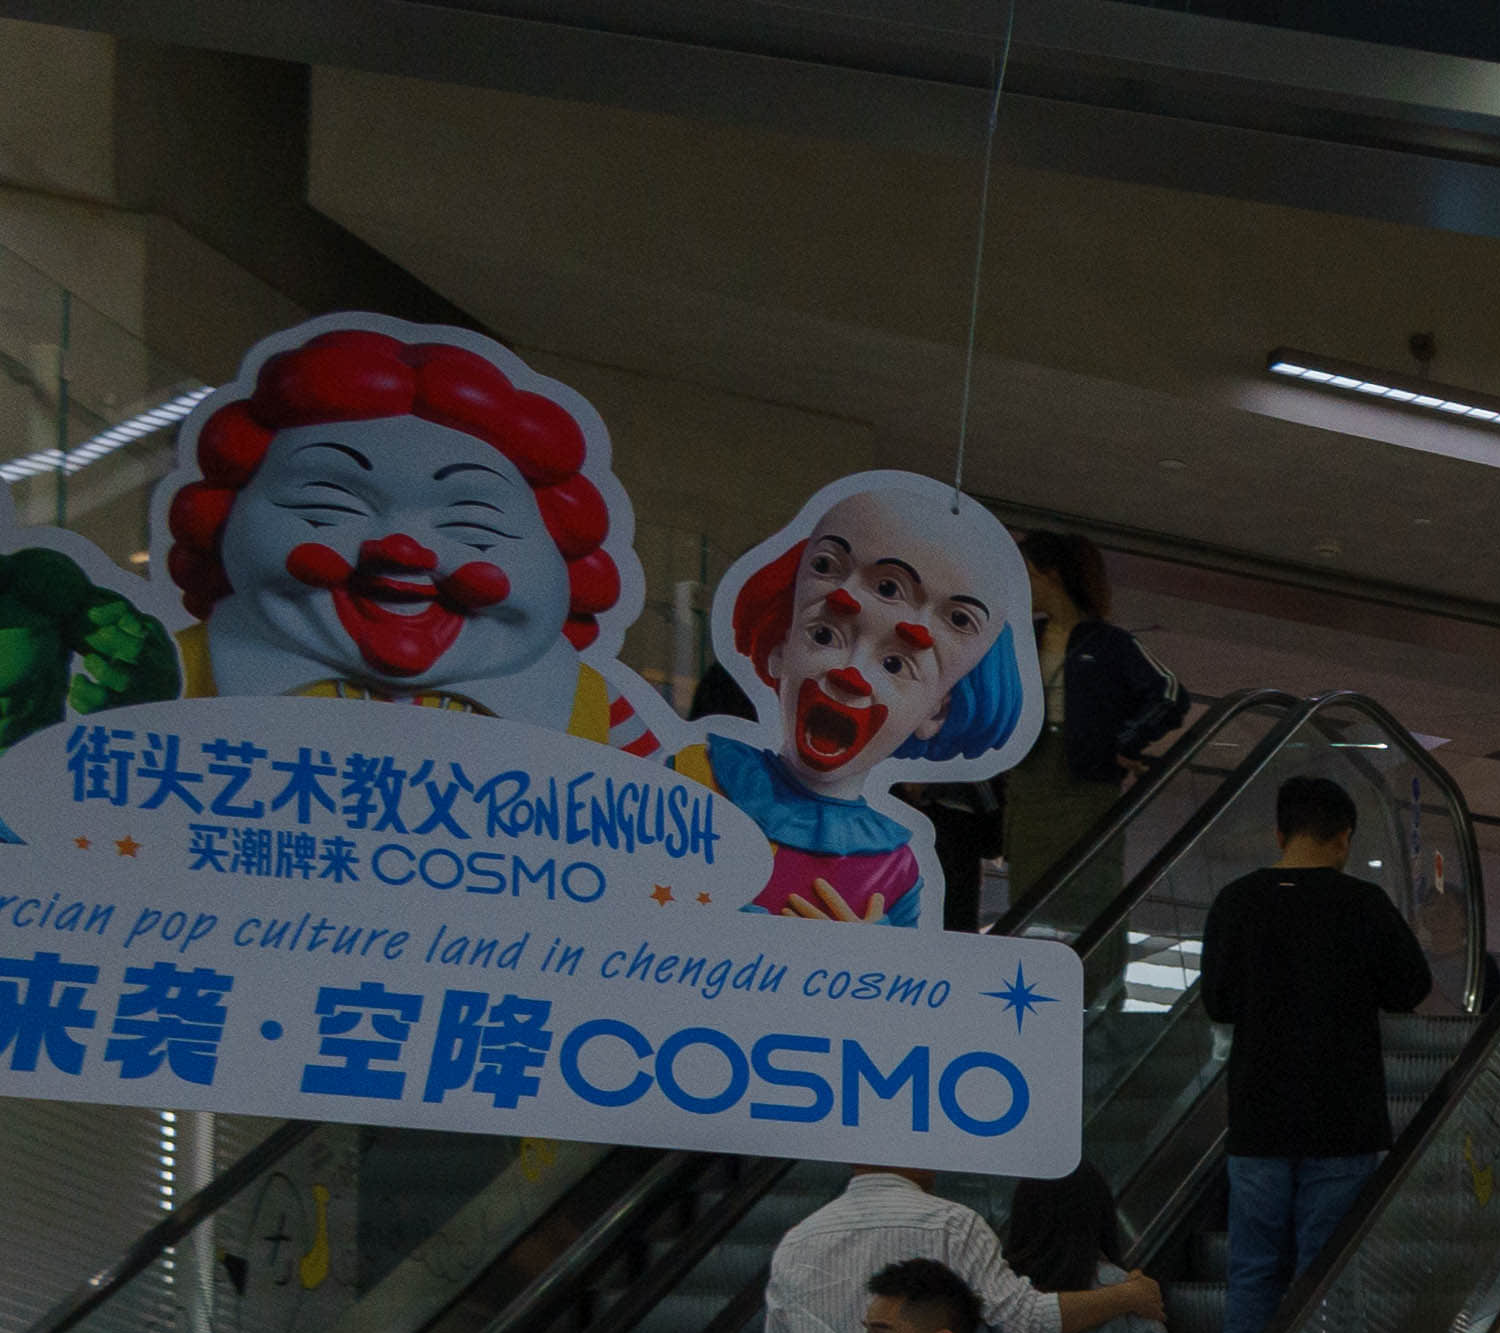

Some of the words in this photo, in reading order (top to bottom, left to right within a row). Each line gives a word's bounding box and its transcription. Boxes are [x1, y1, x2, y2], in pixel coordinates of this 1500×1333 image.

[66, 725, 471, 839] 街头艺术教父
[188, 823, 360, 883] 买潮牌来
[371, 843, 606, 903] COSMO
[123, 907, 218, 953] pop
[233, 912, 410, 958] culture
[425, 925, 530, 970] land
[541, 938, 584, 976] in
[601, 942, 788, 999] chengdu
[803, 969, 950, 1008] cosmo
[560, 1018, 1030, 1137] COSMO
